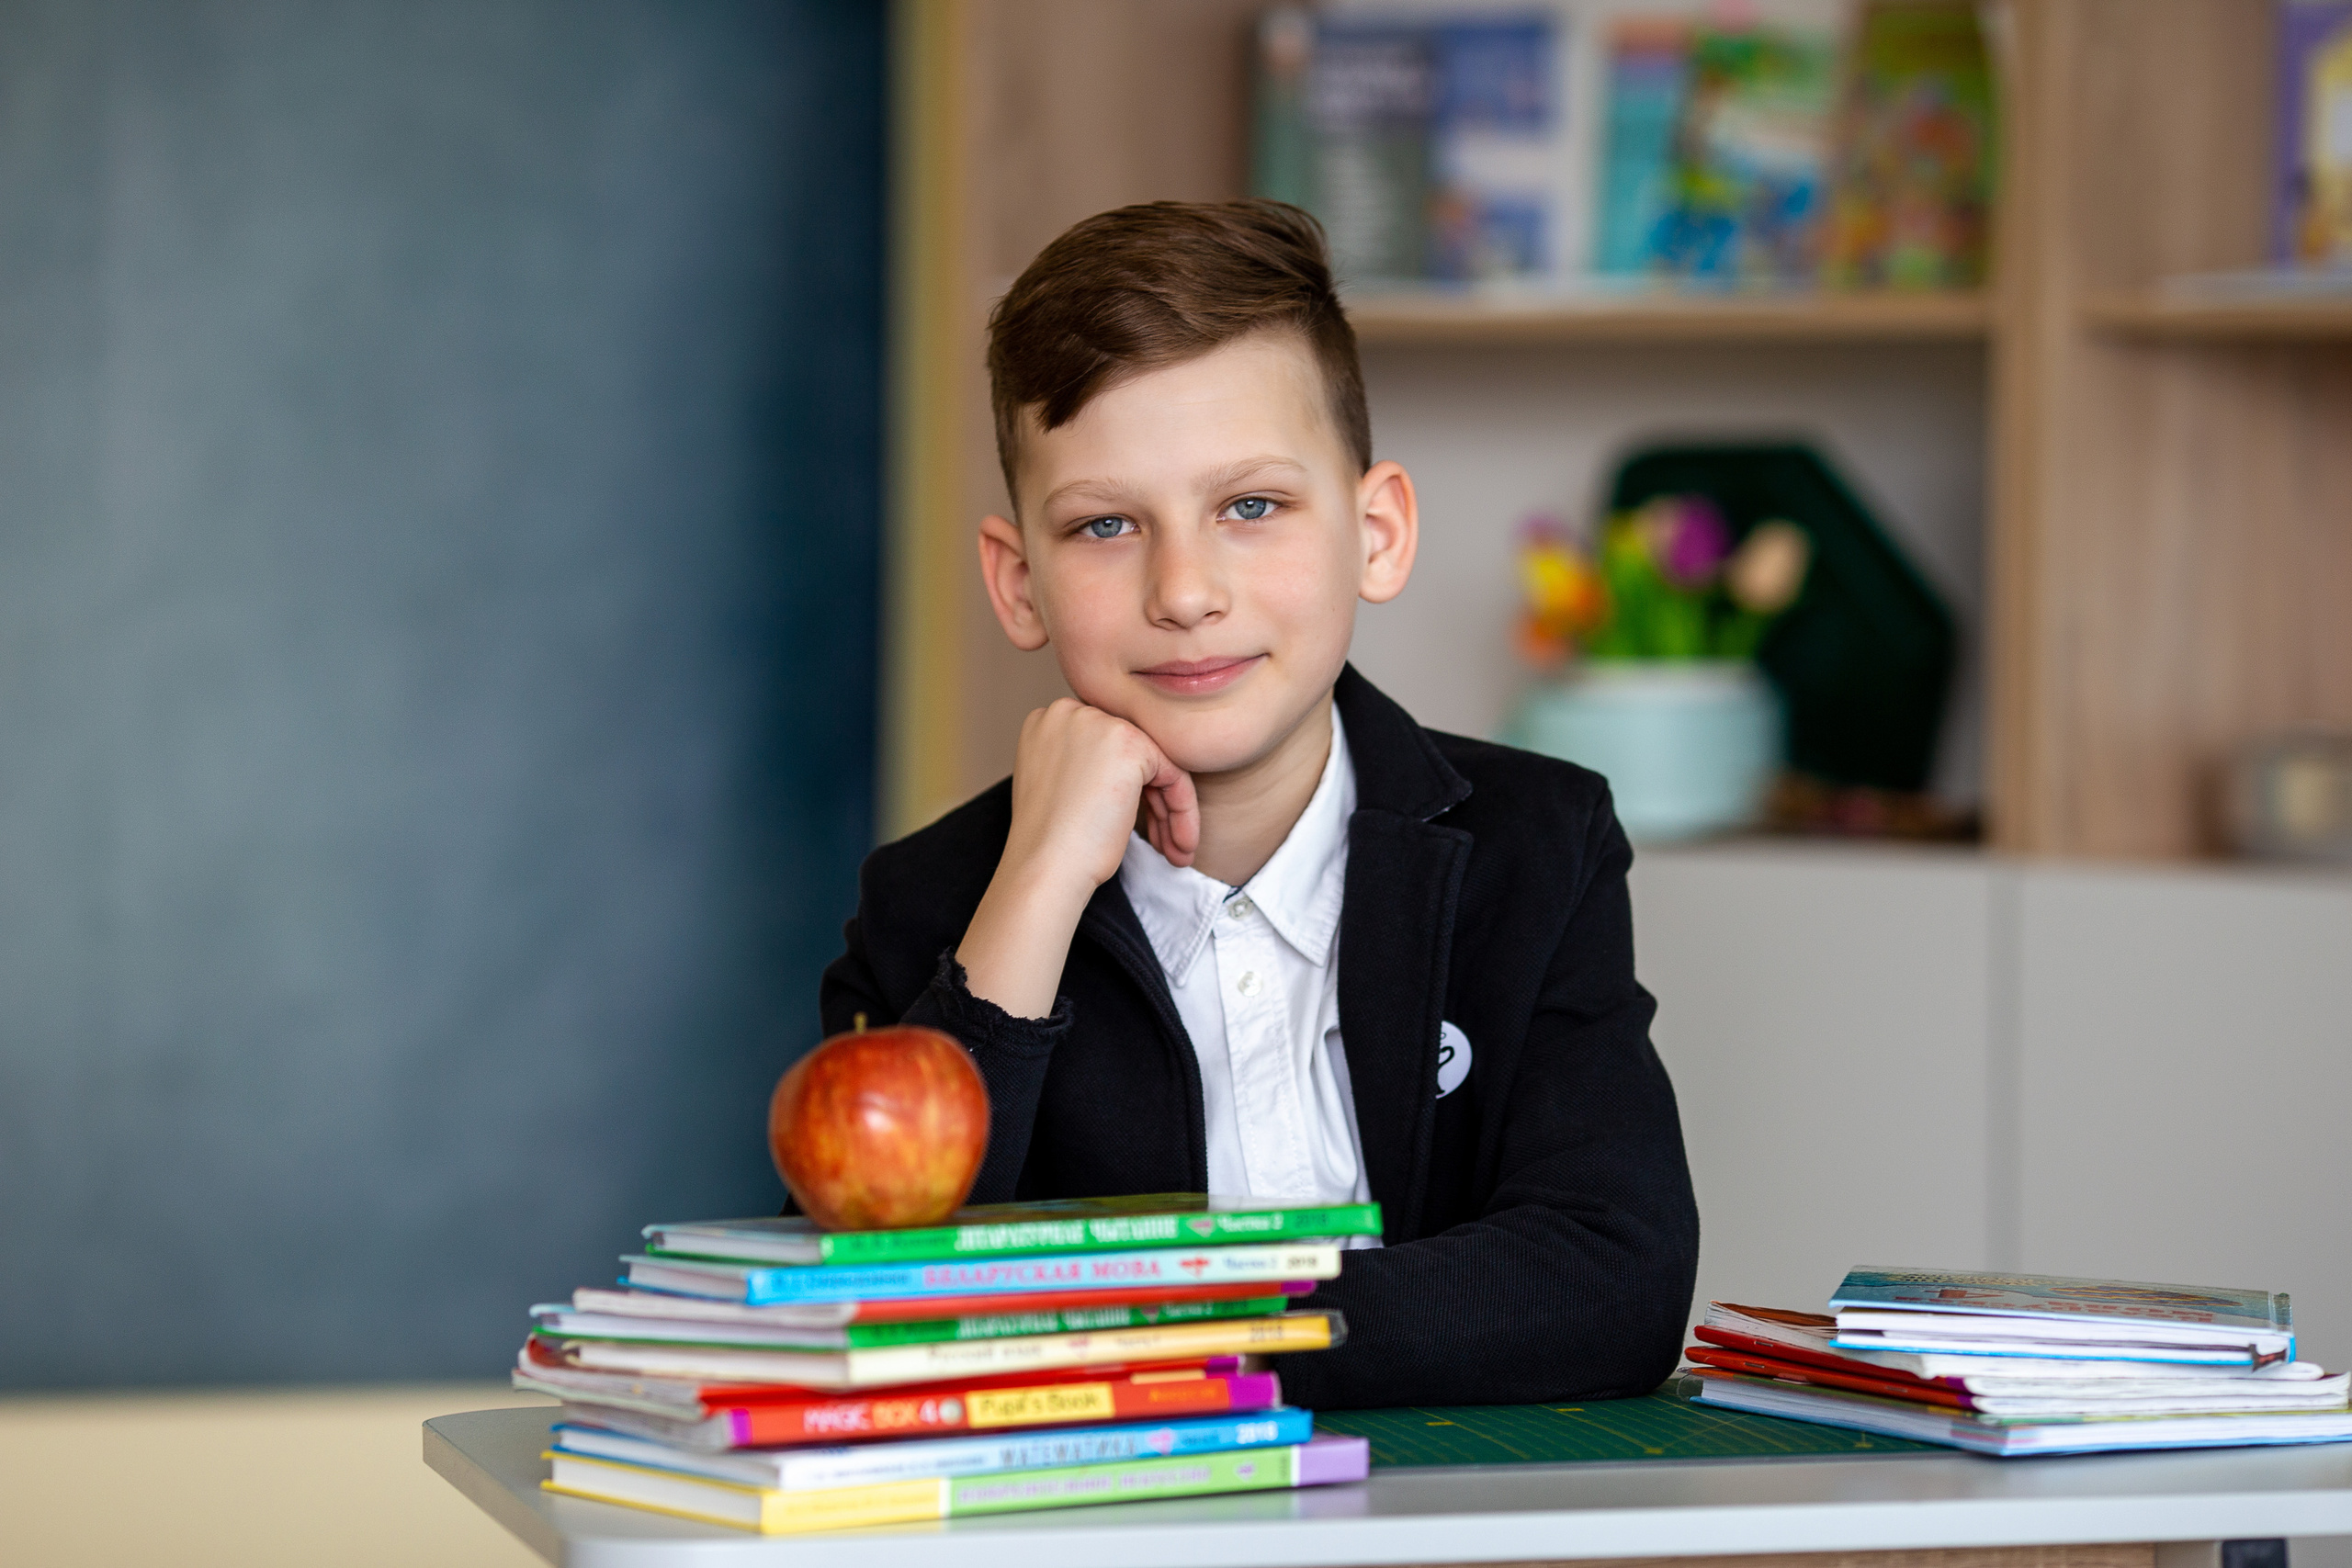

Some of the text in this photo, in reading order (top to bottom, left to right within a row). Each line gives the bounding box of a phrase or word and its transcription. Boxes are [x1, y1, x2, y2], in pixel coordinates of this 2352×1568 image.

[922, 1261, 1081, 1288] БЕЛАРУСКАЯ
[1091, 1258, 1162, 1280] МОВА
[1923, 1289, 2005, 1299] 4
[802, 1401, 872, 1433] MAGIC
[873, 1400, 919, 1427] BOX
[1047, 1390, 1099, 1411] Book
[1235, 1420, 1279, 1445] 2018
